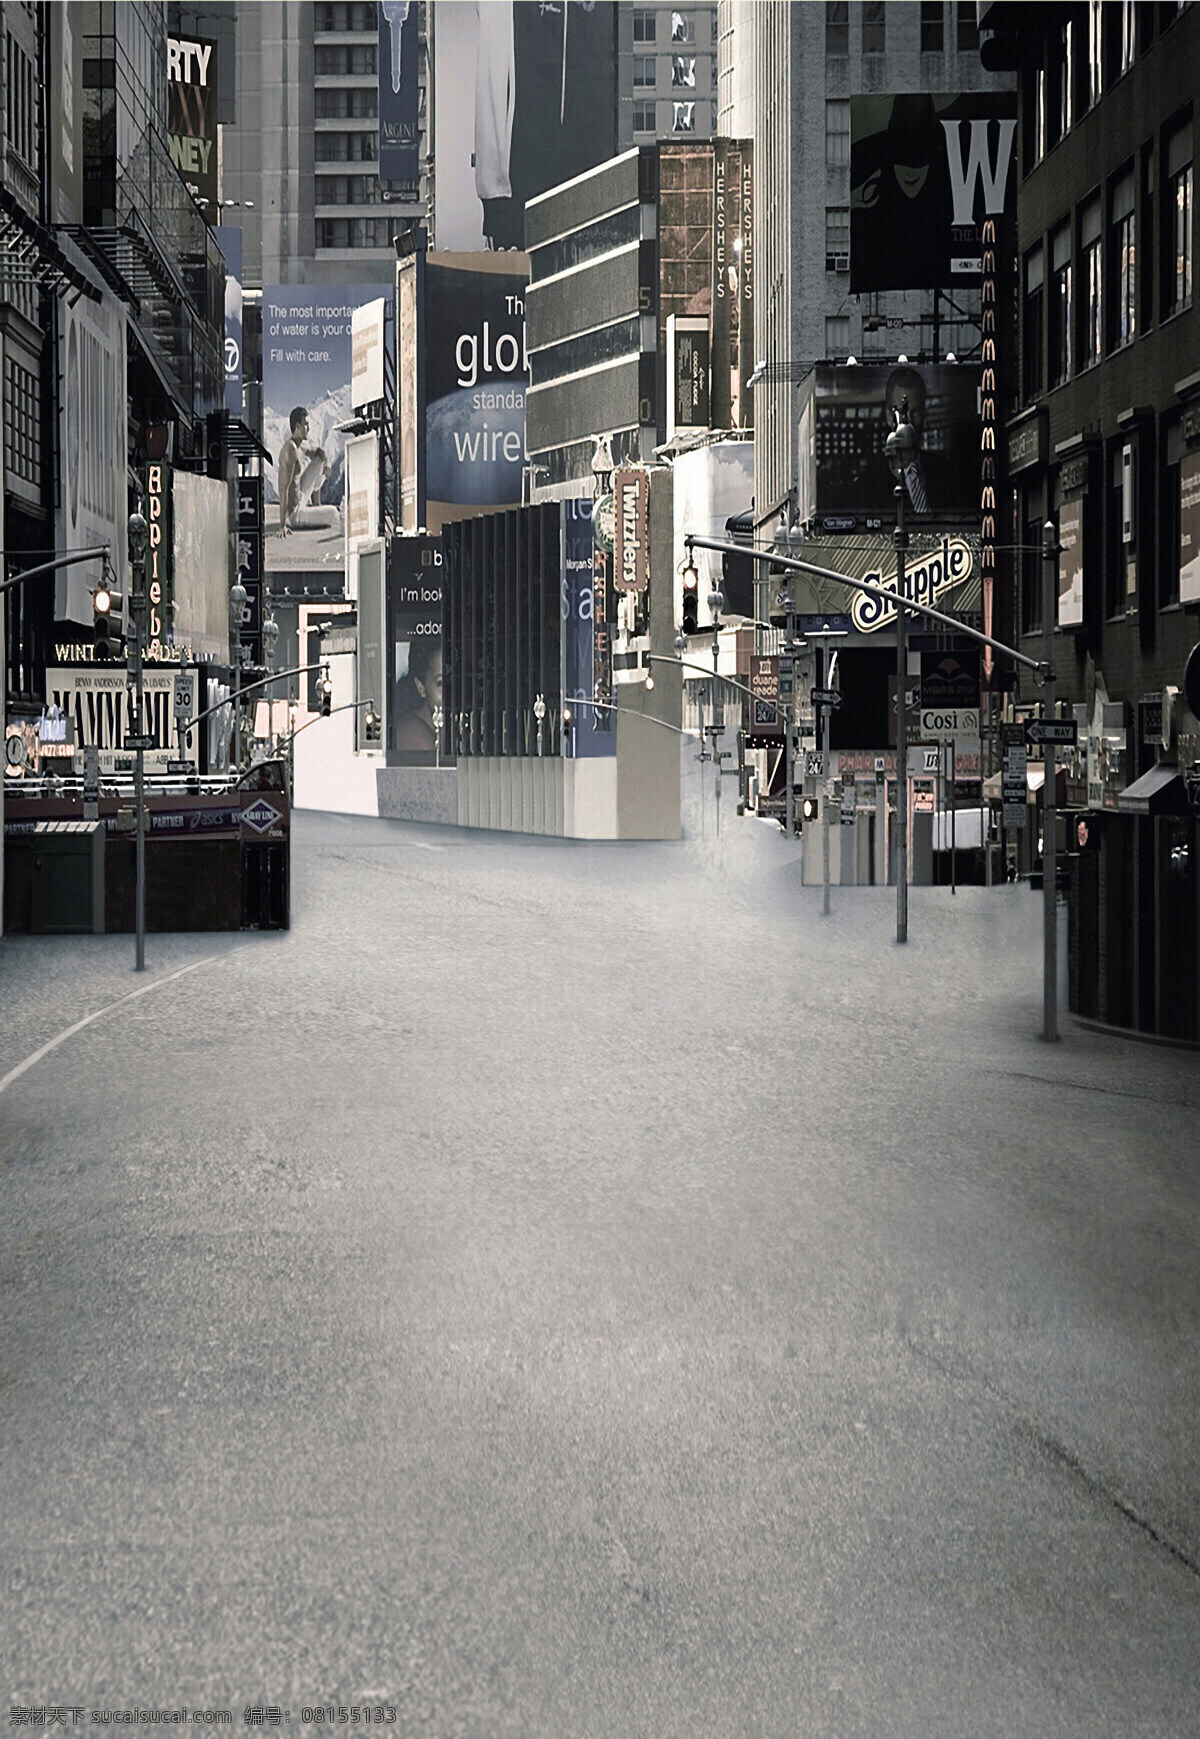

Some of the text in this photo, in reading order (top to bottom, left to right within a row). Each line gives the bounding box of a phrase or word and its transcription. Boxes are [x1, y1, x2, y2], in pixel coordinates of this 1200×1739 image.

[381, 121, 416, 138] ARGENT
[940, 119, 1018, 226] W
[716, 161, 725, 298] HERSHEYS
[743, 163, 752, 299] HERSHEYS
[268, 304, 287, 318] The
[289, 304, 313, 318] most
[505, 296, 526, 315] Th
[269, 322, 280, 335] of
[282, 324, 309, 336] water
[311, 322, 320, 336] is
[322, 324, 344, 338] your
[270, 349, 332, 362] Fill with care.
[473, 389, 526, 410] standa
[622, 480, 641, 582] Twizzlers
[400, 586, 419, 602] I'm
[752, 673, 779, 686] duane
[175, 692, 191, 706] 30
[923, 711, 958, 729] Così
[1032, 726, 1047, 738] ONE
[1054, 726, 1071, 738] WAY
[152, 815, 184, 828] PARTNER
[201, 813, 224, 825] asics
